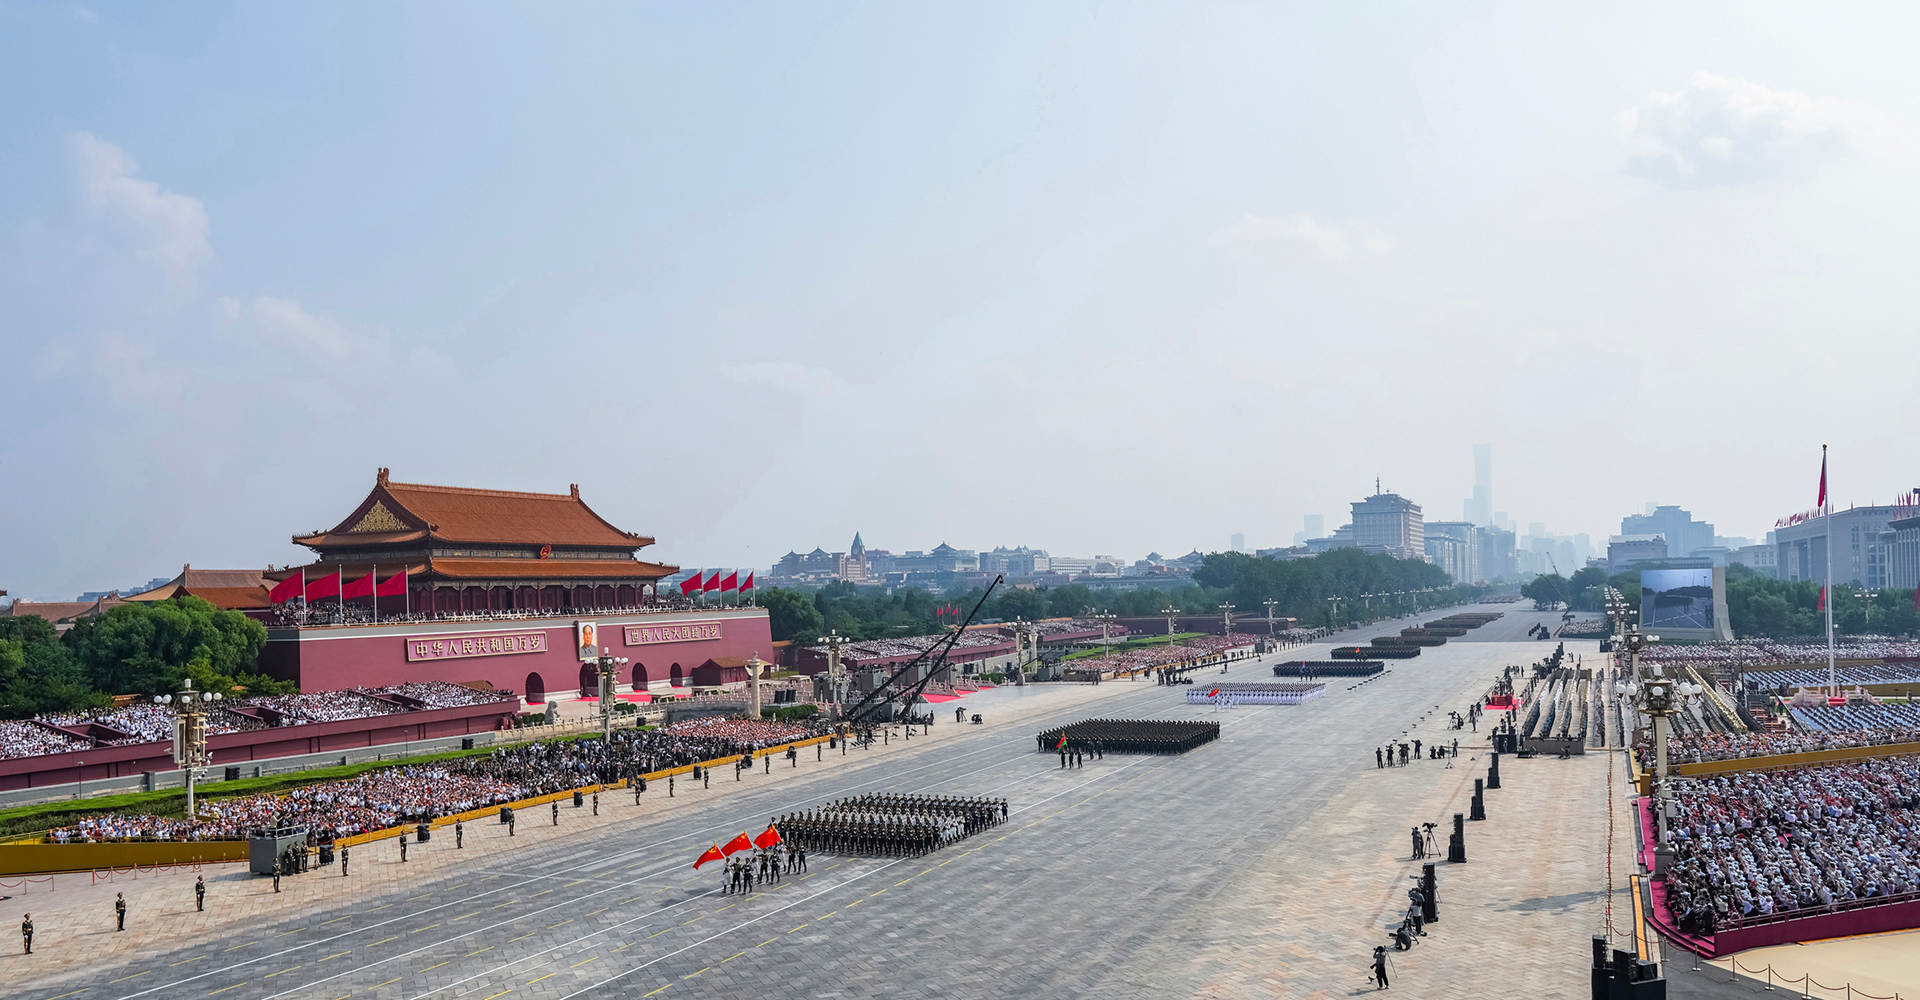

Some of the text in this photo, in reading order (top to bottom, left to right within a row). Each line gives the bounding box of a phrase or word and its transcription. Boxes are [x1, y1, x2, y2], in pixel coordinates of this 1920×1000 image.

[630, 625, 718, 642] 世界人民大团结万岁
[416, 635, 540, 657] 中华人民共和国万岁
